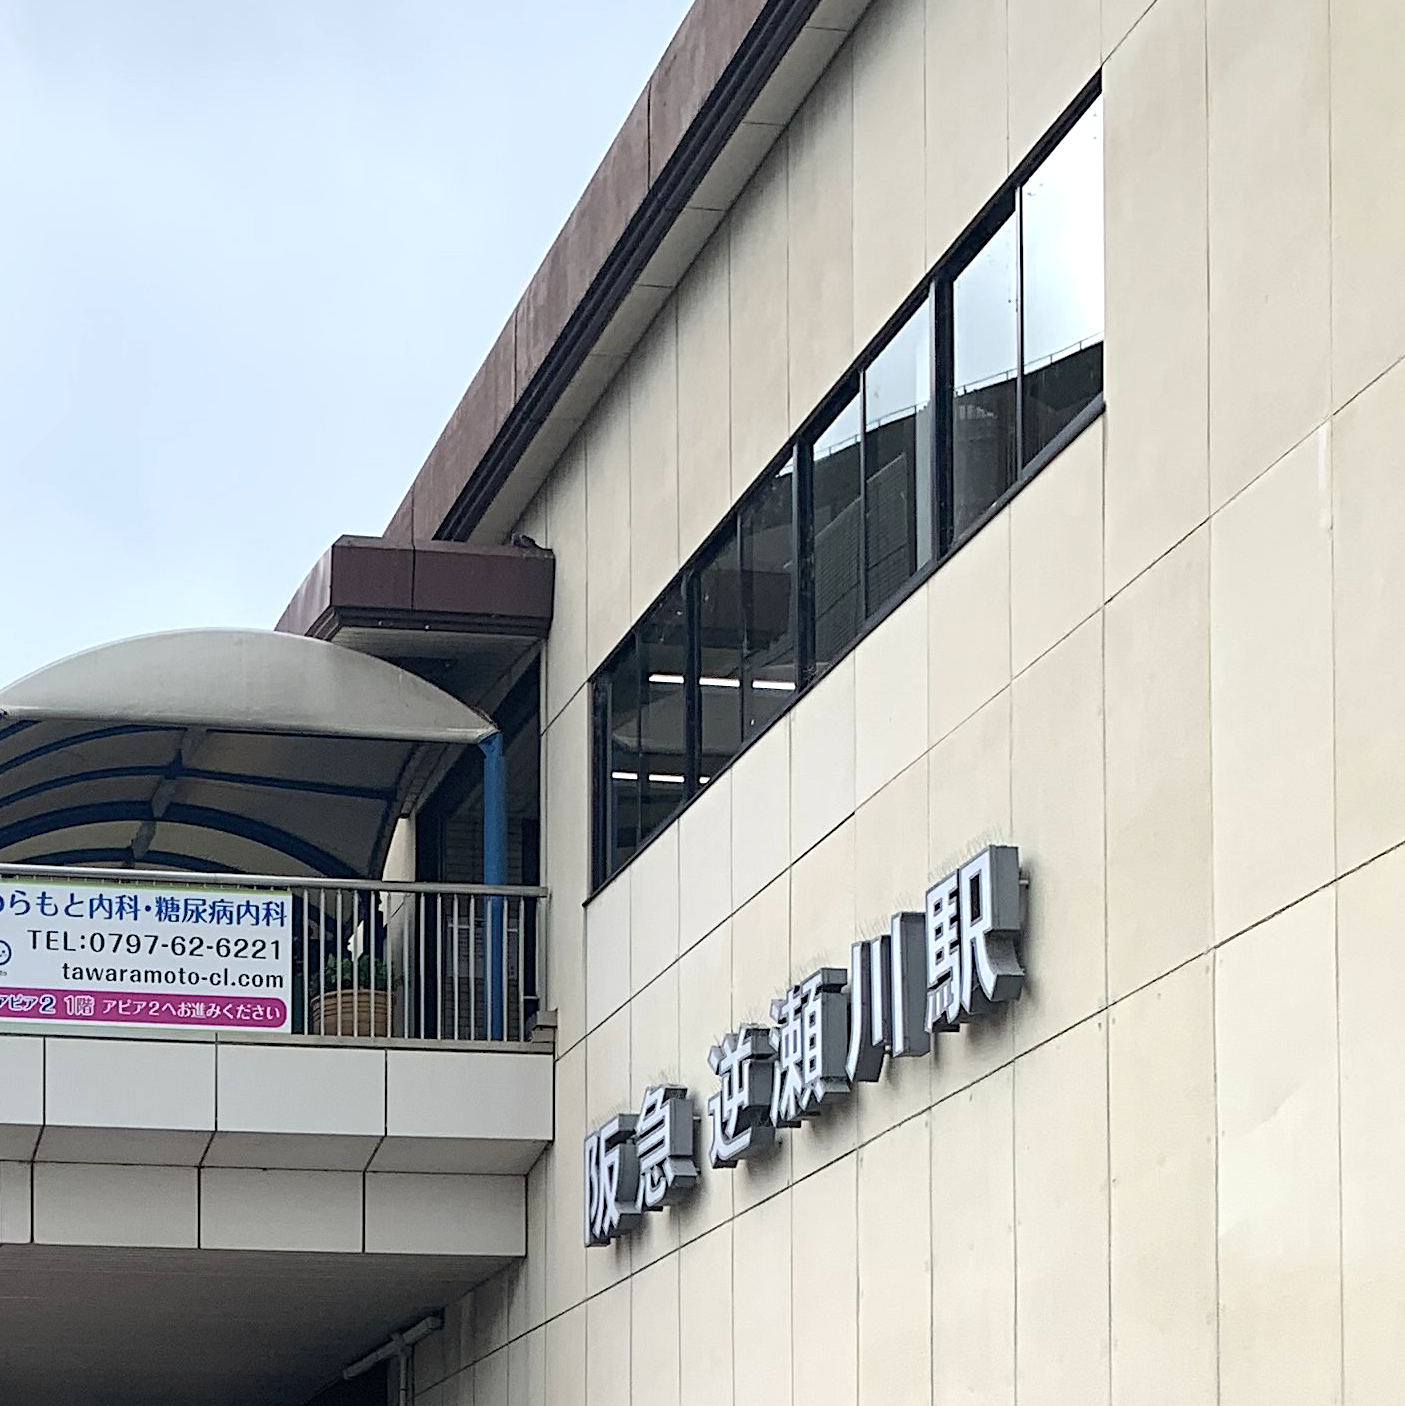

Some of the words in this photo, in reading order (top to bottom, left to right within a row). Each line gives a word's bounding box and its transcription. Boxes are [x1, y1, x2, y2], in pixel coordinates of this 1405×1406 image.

[27, 929, 282, 961] TEL:0797-62-6221
[63, 963, 285, 989] tawaramoto-cl.com
[64, 996, 94, 1016] 1階
[102, 999, 281, 1021] アピア2へお進みください
